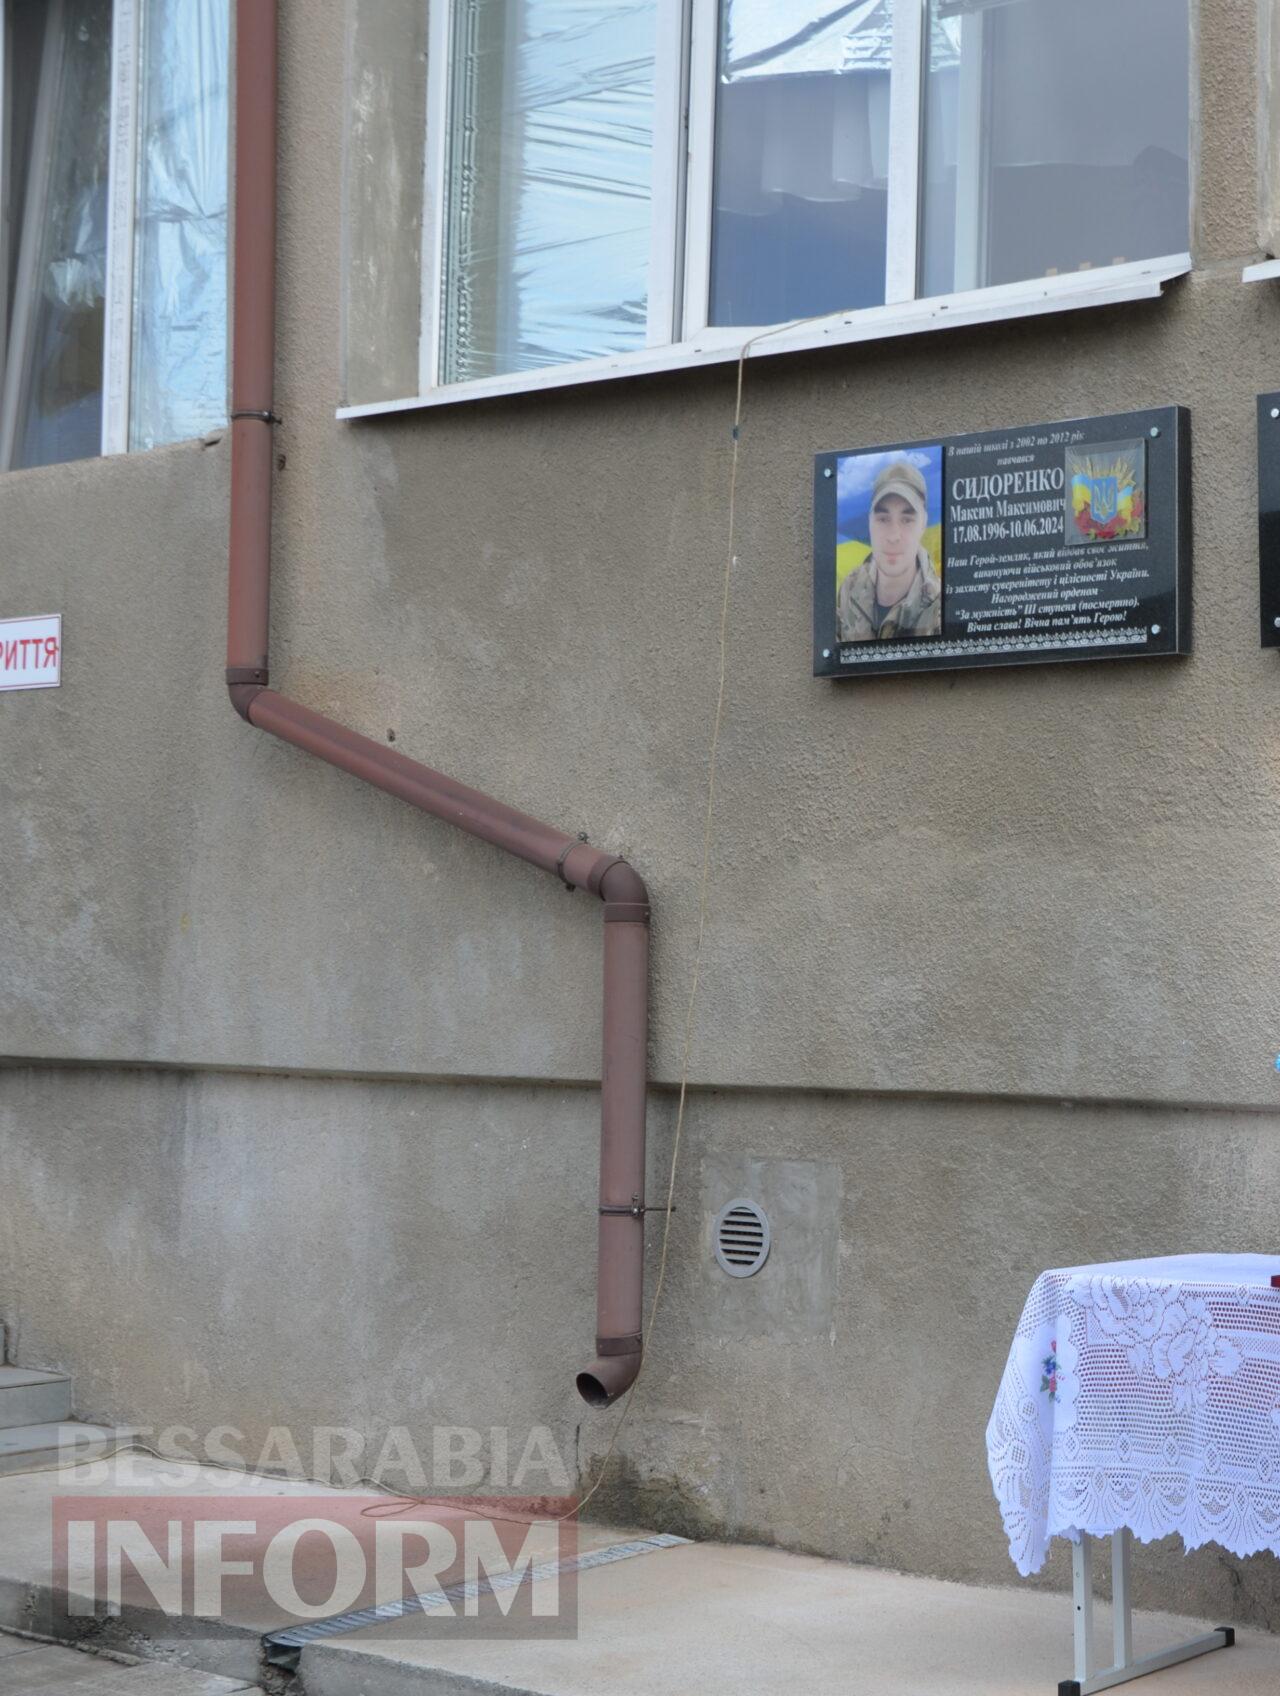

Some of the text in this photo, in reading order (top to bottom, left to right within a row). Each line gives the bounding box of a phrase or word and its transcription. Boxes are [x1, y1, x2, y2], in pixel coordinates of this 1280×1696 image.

[1050, 431, 1070, 444] 2012
[952, 467, 1065, 503] СИДОРЕНКО
[950, 498, 1067, 523] Максим Максимович
[953, 515, 1064, 544] 17.08.1996-10.06.2024
[947, 557, 968, 568] Наш
[969, 553, 1031, 568] Герой-земляк,
[1032, 548, 1056, 560] який
[954, 582, 990, 594] захисту
[991, 576, 1052, 593] суверенітету
[1059, 570, 1108, 587] цілісності
[1110, 568, 1150, 582] України.
[973, 567, 1022, 579] виконуючи
[1023, 561, 1071, 574] військовий
[991, 587, 1099, 605] Нагороджений орденом
[1078, 595, 1140, 612] (посмертно).
[966, 621, 993, 633] Вічна
[993, 618, 1022, 631] слава!
[1023, 616, 1050, 628] Вічна
[1093, 609, 1127, 625] Герою!
